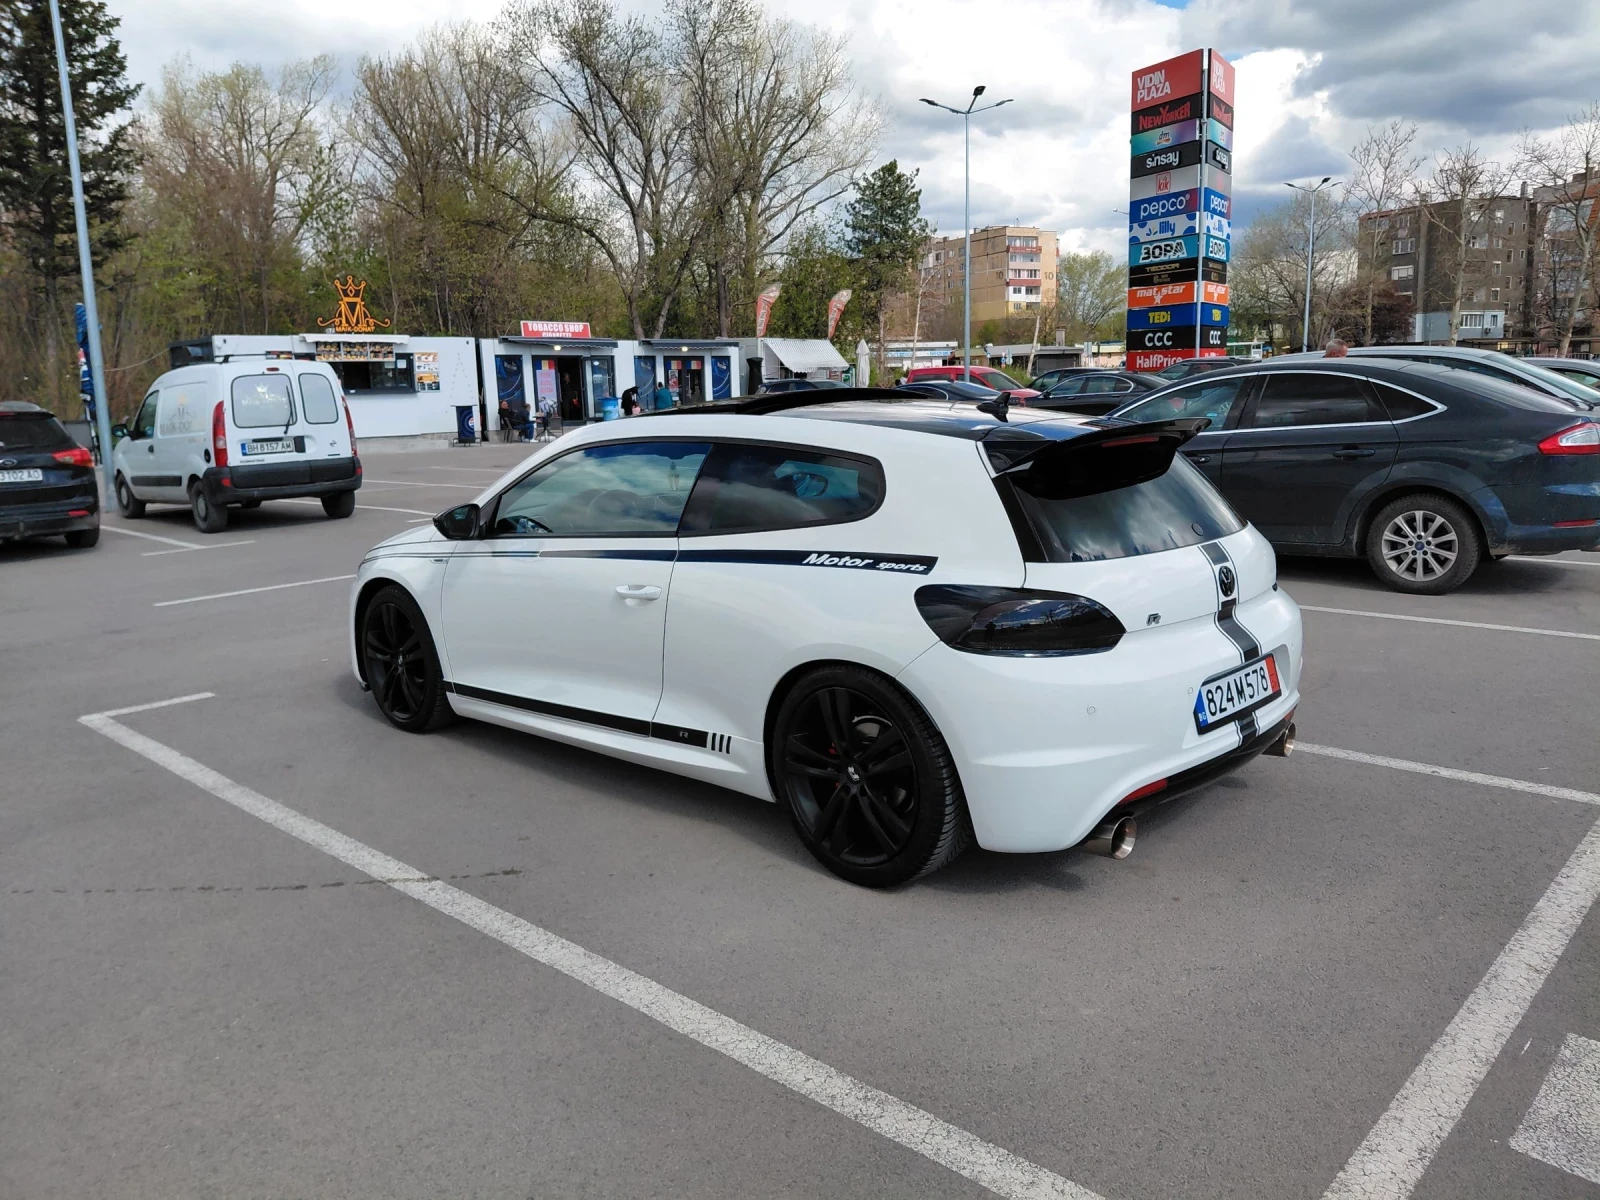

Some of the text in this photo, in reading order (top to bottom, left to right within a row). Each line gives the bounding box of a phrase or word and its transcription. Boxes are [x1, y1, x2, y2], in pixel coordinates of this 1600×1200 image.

[1137, 69, 1165, 90] VIDIN
[1137, 81, 1171, 104] PLAZA
[1159, 130, 1170, 141] dm
[1145, 150, 1180, 169] sinsay
[1140, 196, 1187, 220] pepco
[1210, 194, 1229, 213] pepco
[1159, 220, 1176, 236] lilly
[1161, 284, 1186, 295] star
[1148, 311, 1171, 324] TEDi
[527, 322, 584, 333] TOBACCO SHOP
[1144, 331, 1173, 347] CCC
[1209, 330, 1221, 345] CCC
[260, 442, 280, 453] 8157
[802, 553, 928, 571] Motor sports
